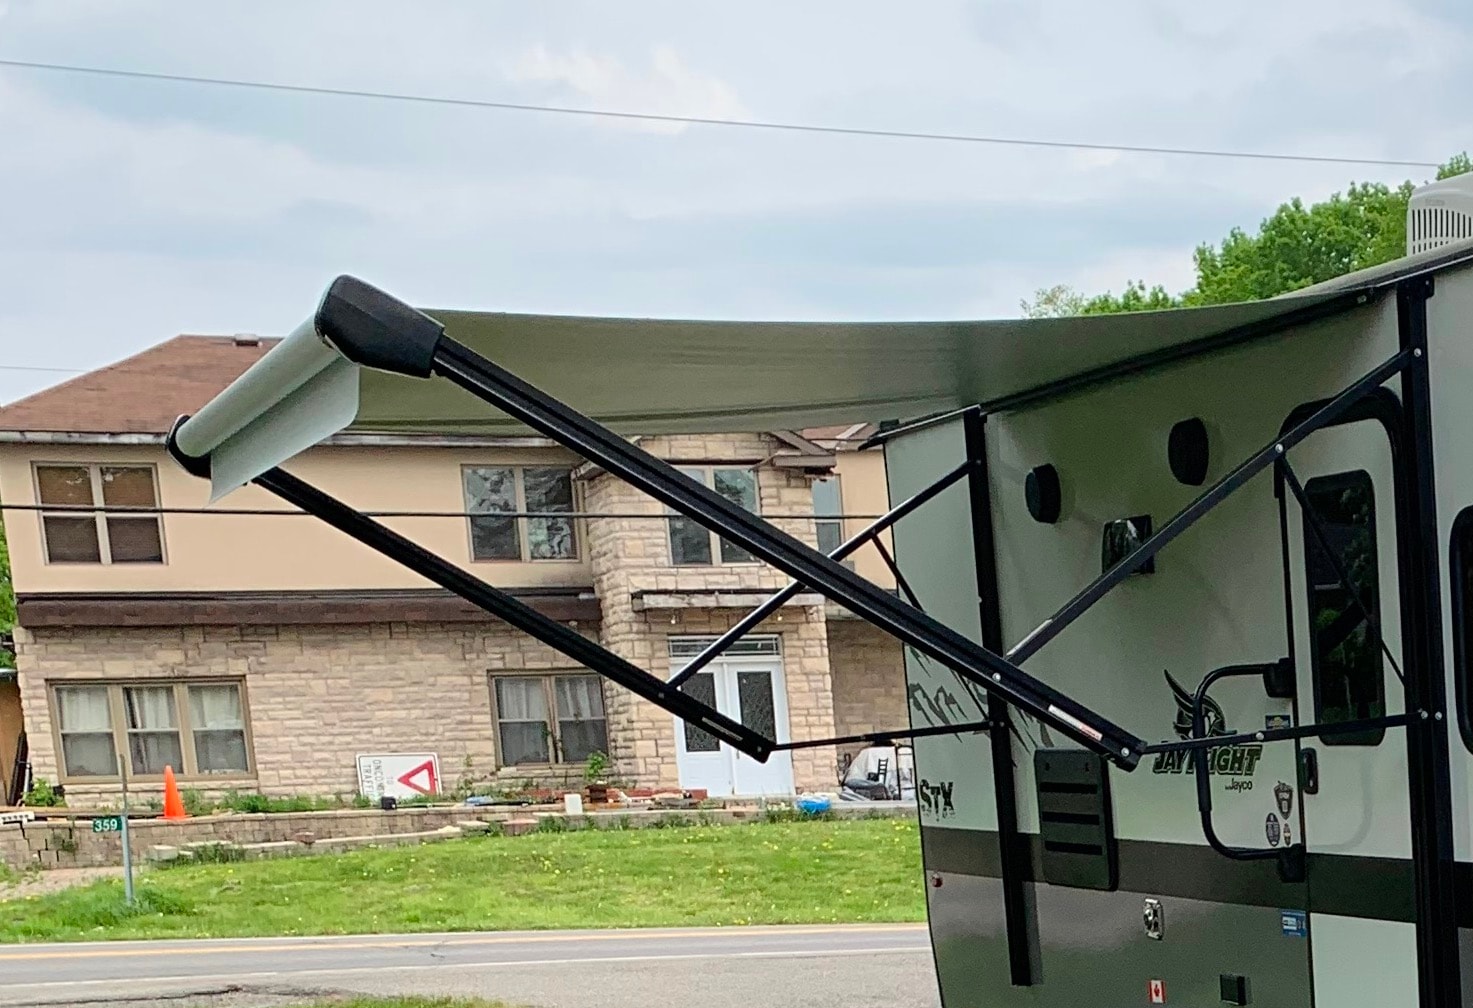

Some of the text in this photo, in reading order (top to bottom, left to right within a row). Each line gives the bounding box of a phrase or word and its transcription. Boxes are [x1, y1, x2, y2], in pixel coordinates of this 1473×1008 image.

[1186, 743, 1263, 776] IGHT
[919, 779, 955, 821] STX
[94, 818, 118, 832] 359
